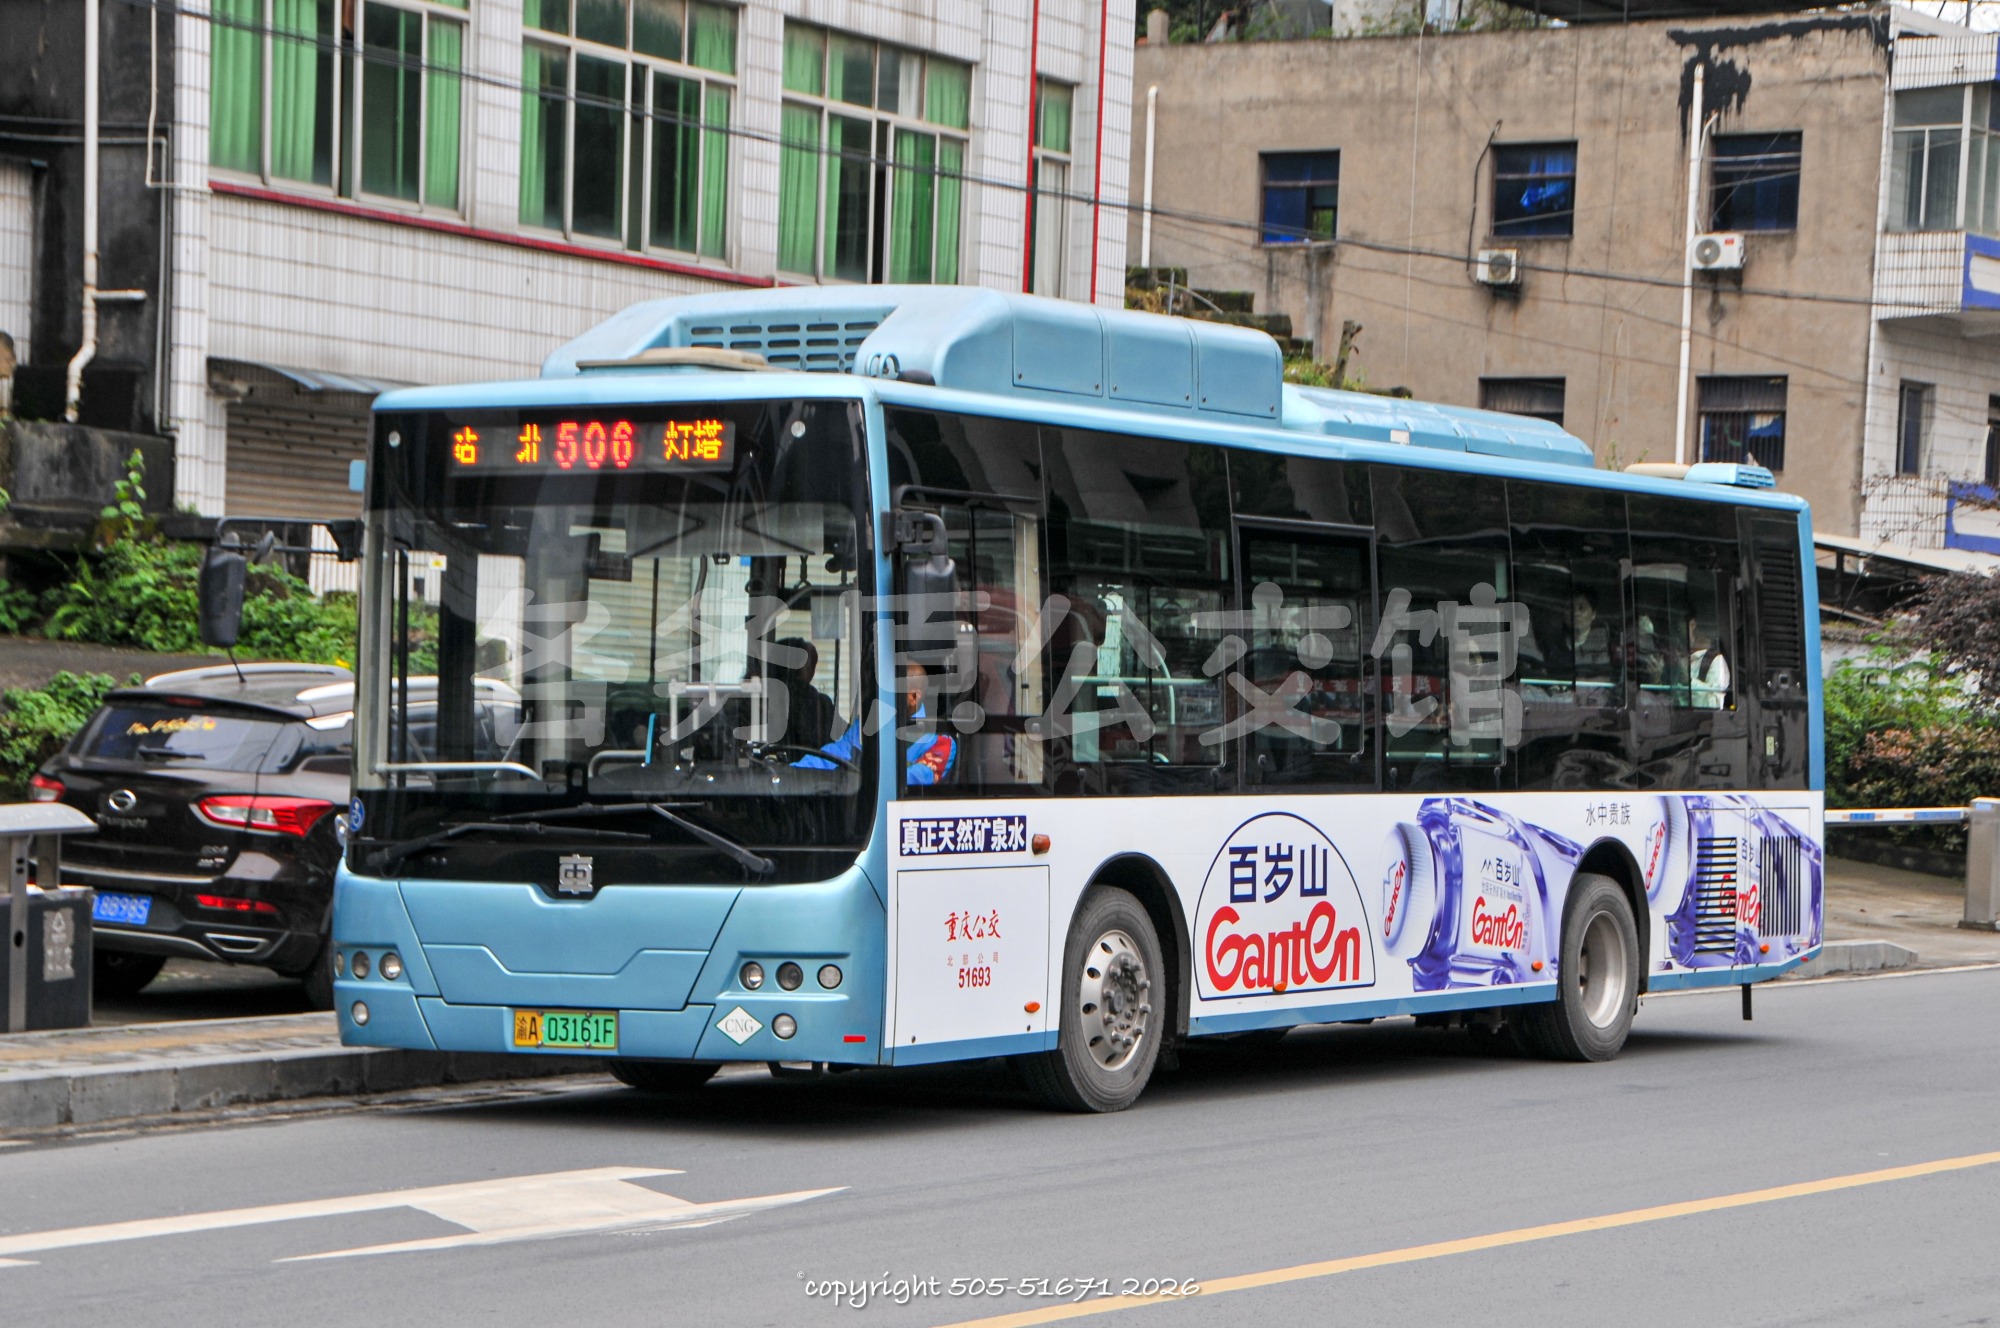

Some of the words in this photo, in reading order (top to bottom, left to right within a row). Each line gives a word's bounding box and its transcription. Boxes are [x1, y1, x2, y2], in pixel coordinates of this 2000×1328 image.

[554, 421, 633, 468] 506
[664, 420, 722, 460] 灯塔
[1585, 802, 1631, 826] 水中贵族
[902, 817, 1026, 855] 真正天然矿泉水
[1229, 842, 1327, 903] 百岁山
[1495, 857, 1520, 887] 百岁山
[944, 909, 1001, 942] 重庆公交
[1472, 896, 1523, 949] Ganten
[1205, 900, 1360, 991] Ganten
[959, 966, 991, 988] 51693
[725, 1018, 754, 1033] CNG
